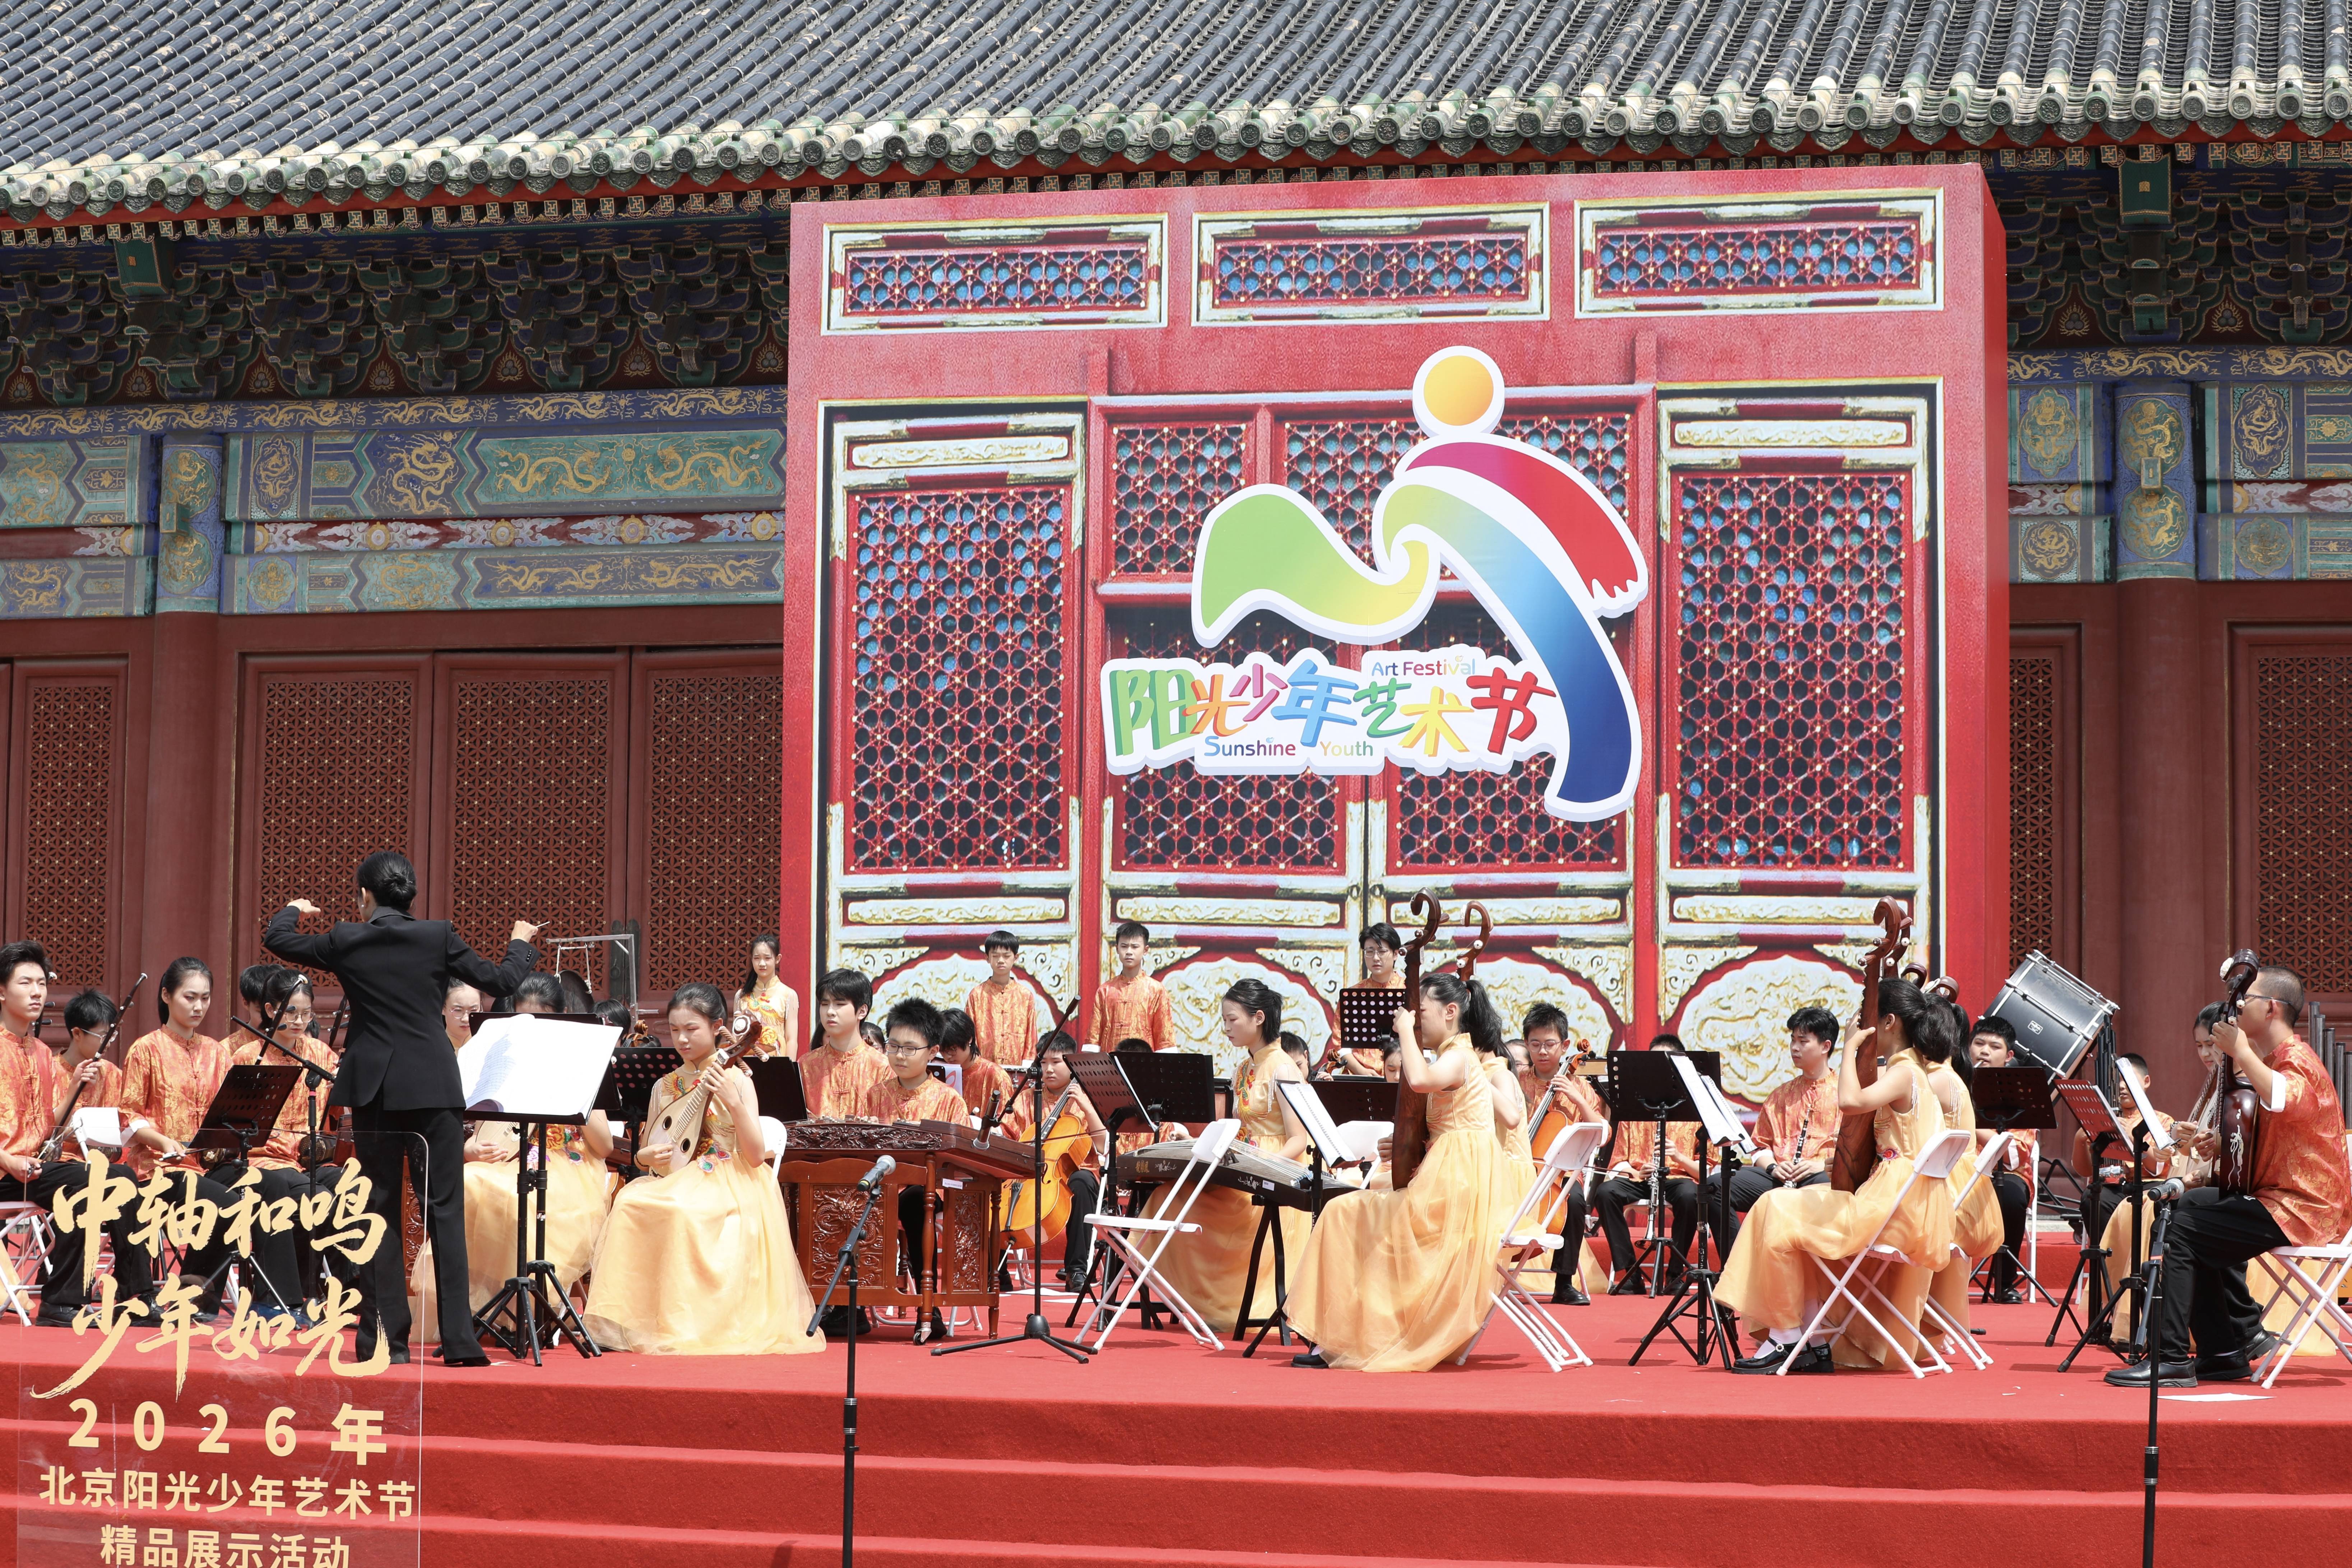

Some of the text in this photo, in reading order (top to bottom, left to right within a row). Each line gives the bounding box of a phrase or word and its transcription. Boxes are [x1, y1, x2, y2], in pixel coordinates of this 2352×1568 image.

[1372, 658, 1475, 676] Art Festival
[1109, 659, 1556, 757] 阳光少年艺术节
[1204, 736, 1373, 756] Sunshine Youth
[53, 1149, 387, 1296] 中轴和鸣
[29, 1272, 391, 1402] 少年如光
[68, 1398, 387, 1466] 2026年
[39, 1466, 416, 1522] 北京阳光少年艺术节
[100, 1524, 349, 1568] 精品展示活动
